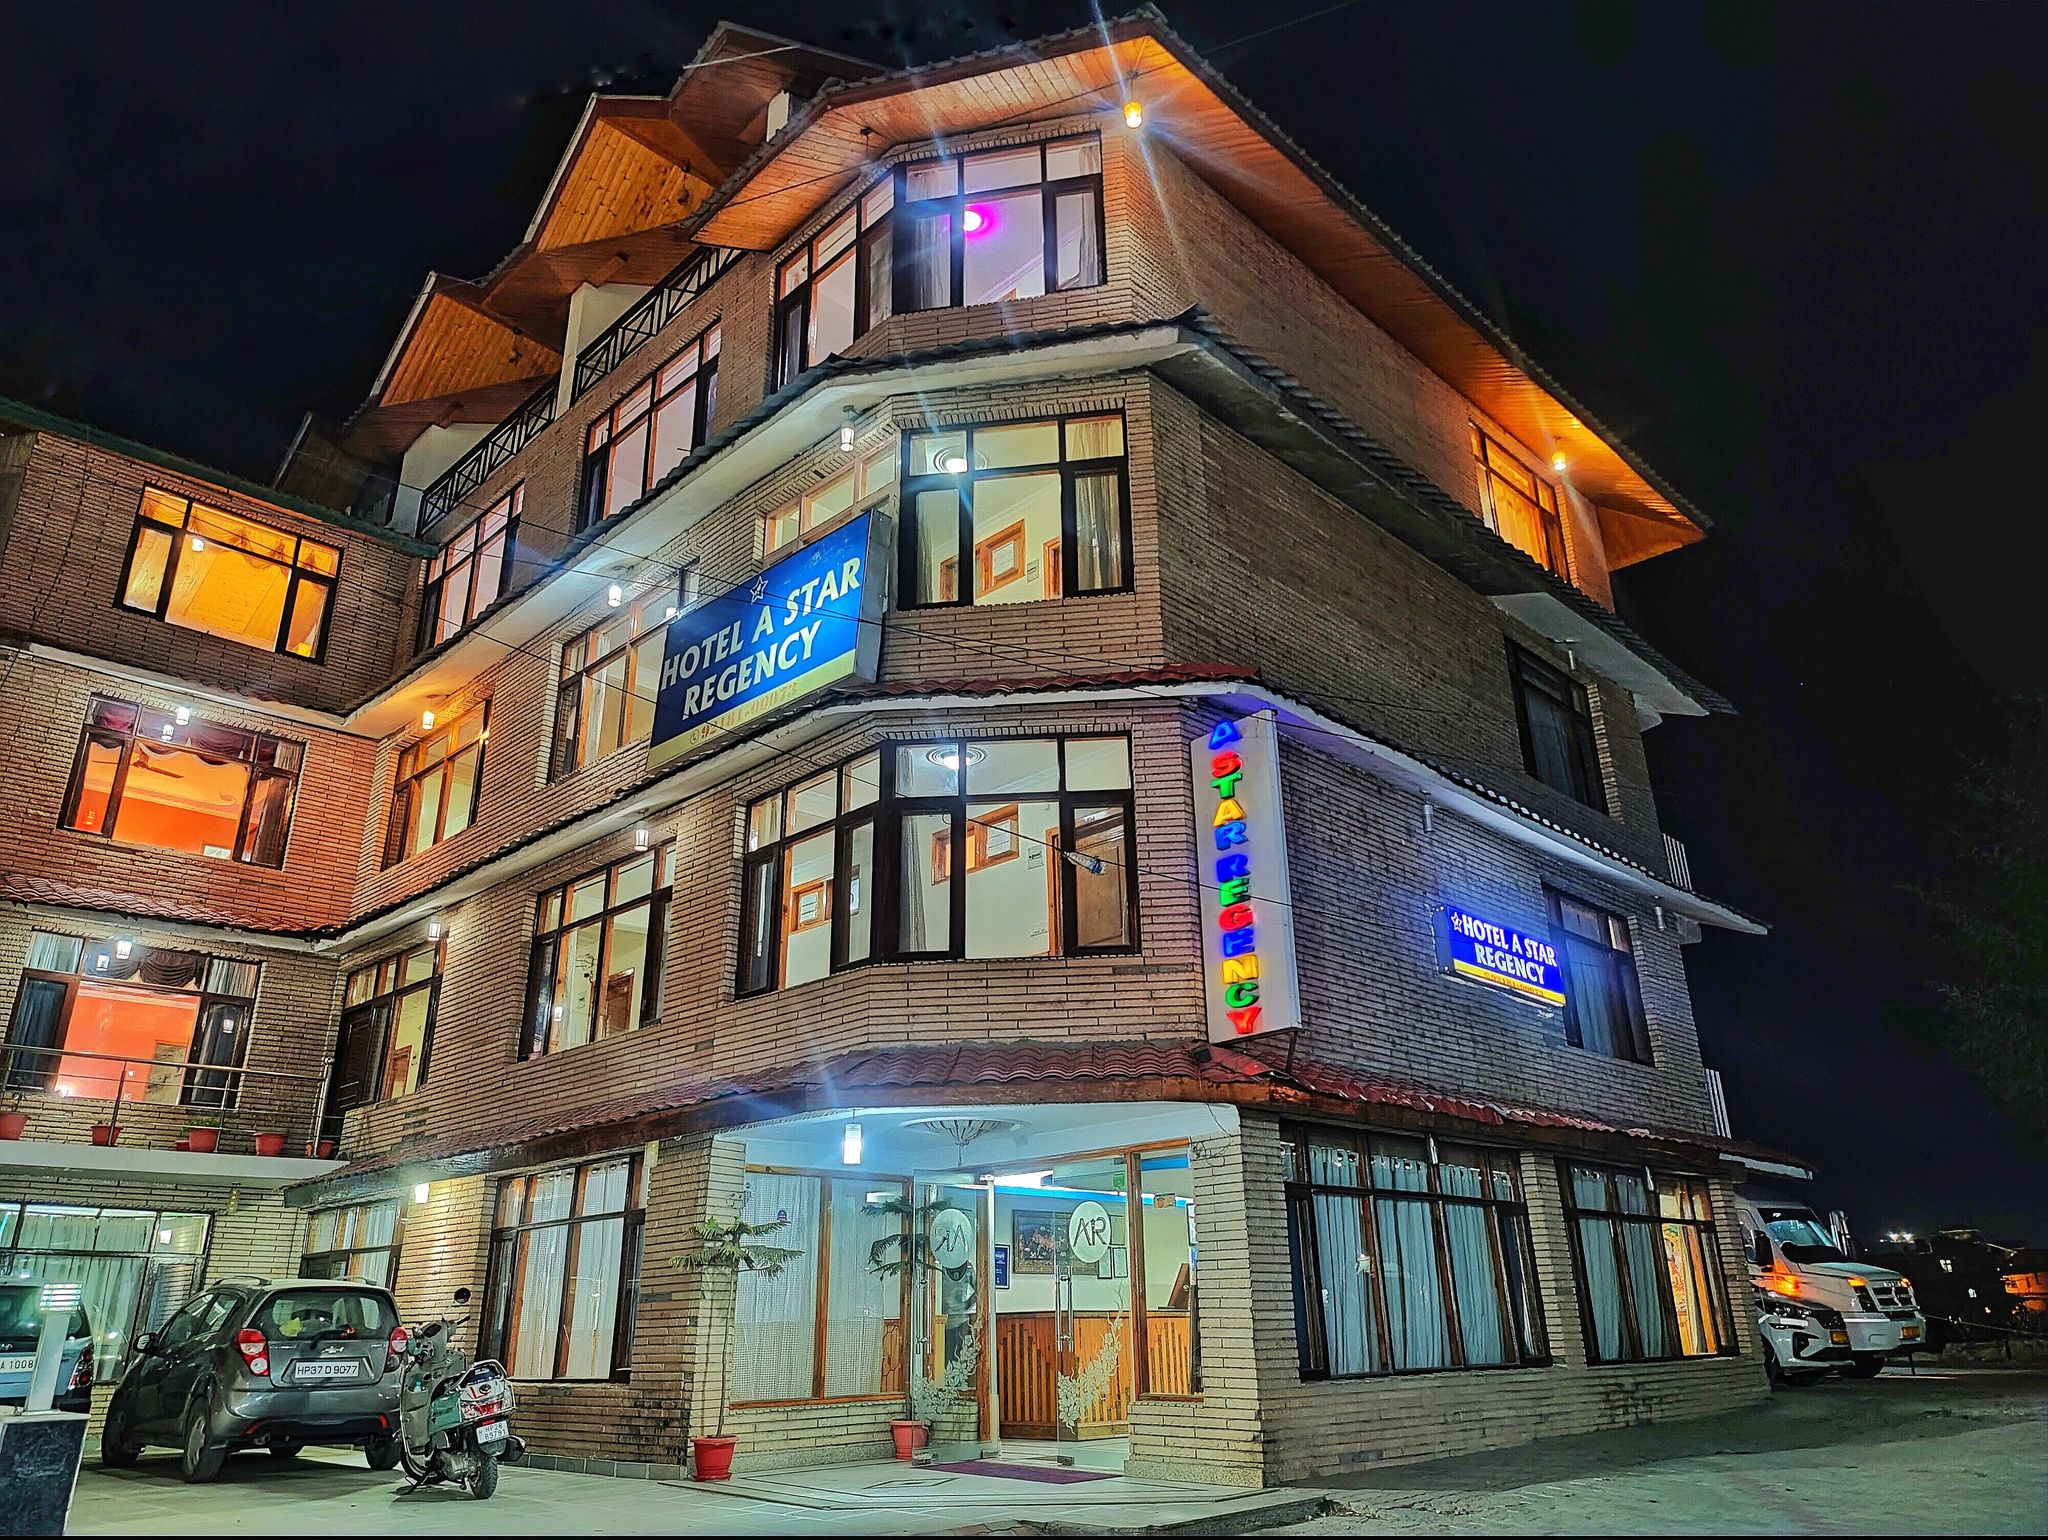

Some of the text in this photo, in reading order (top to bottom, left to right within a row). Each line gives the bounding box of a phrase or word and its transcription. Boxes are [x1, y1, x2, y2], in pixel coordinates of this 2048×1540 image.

[661, 557, 861, 691] HOTEL A STAR
[682, 620, 823, 720] REGENCY
[1208, 719, 1261, 1035] A STAR REGENCY
[1462, 914, 1556, 967] HOTEL A STAR
[1474, 942, 1545, 985] REGENCY
[10, 1360, 34, 1369] 1008
[297, 1365, 323, 1375] HP37
[325, 1366, 332, 1375] D
[485, 1429, 506, 1440] B9791
